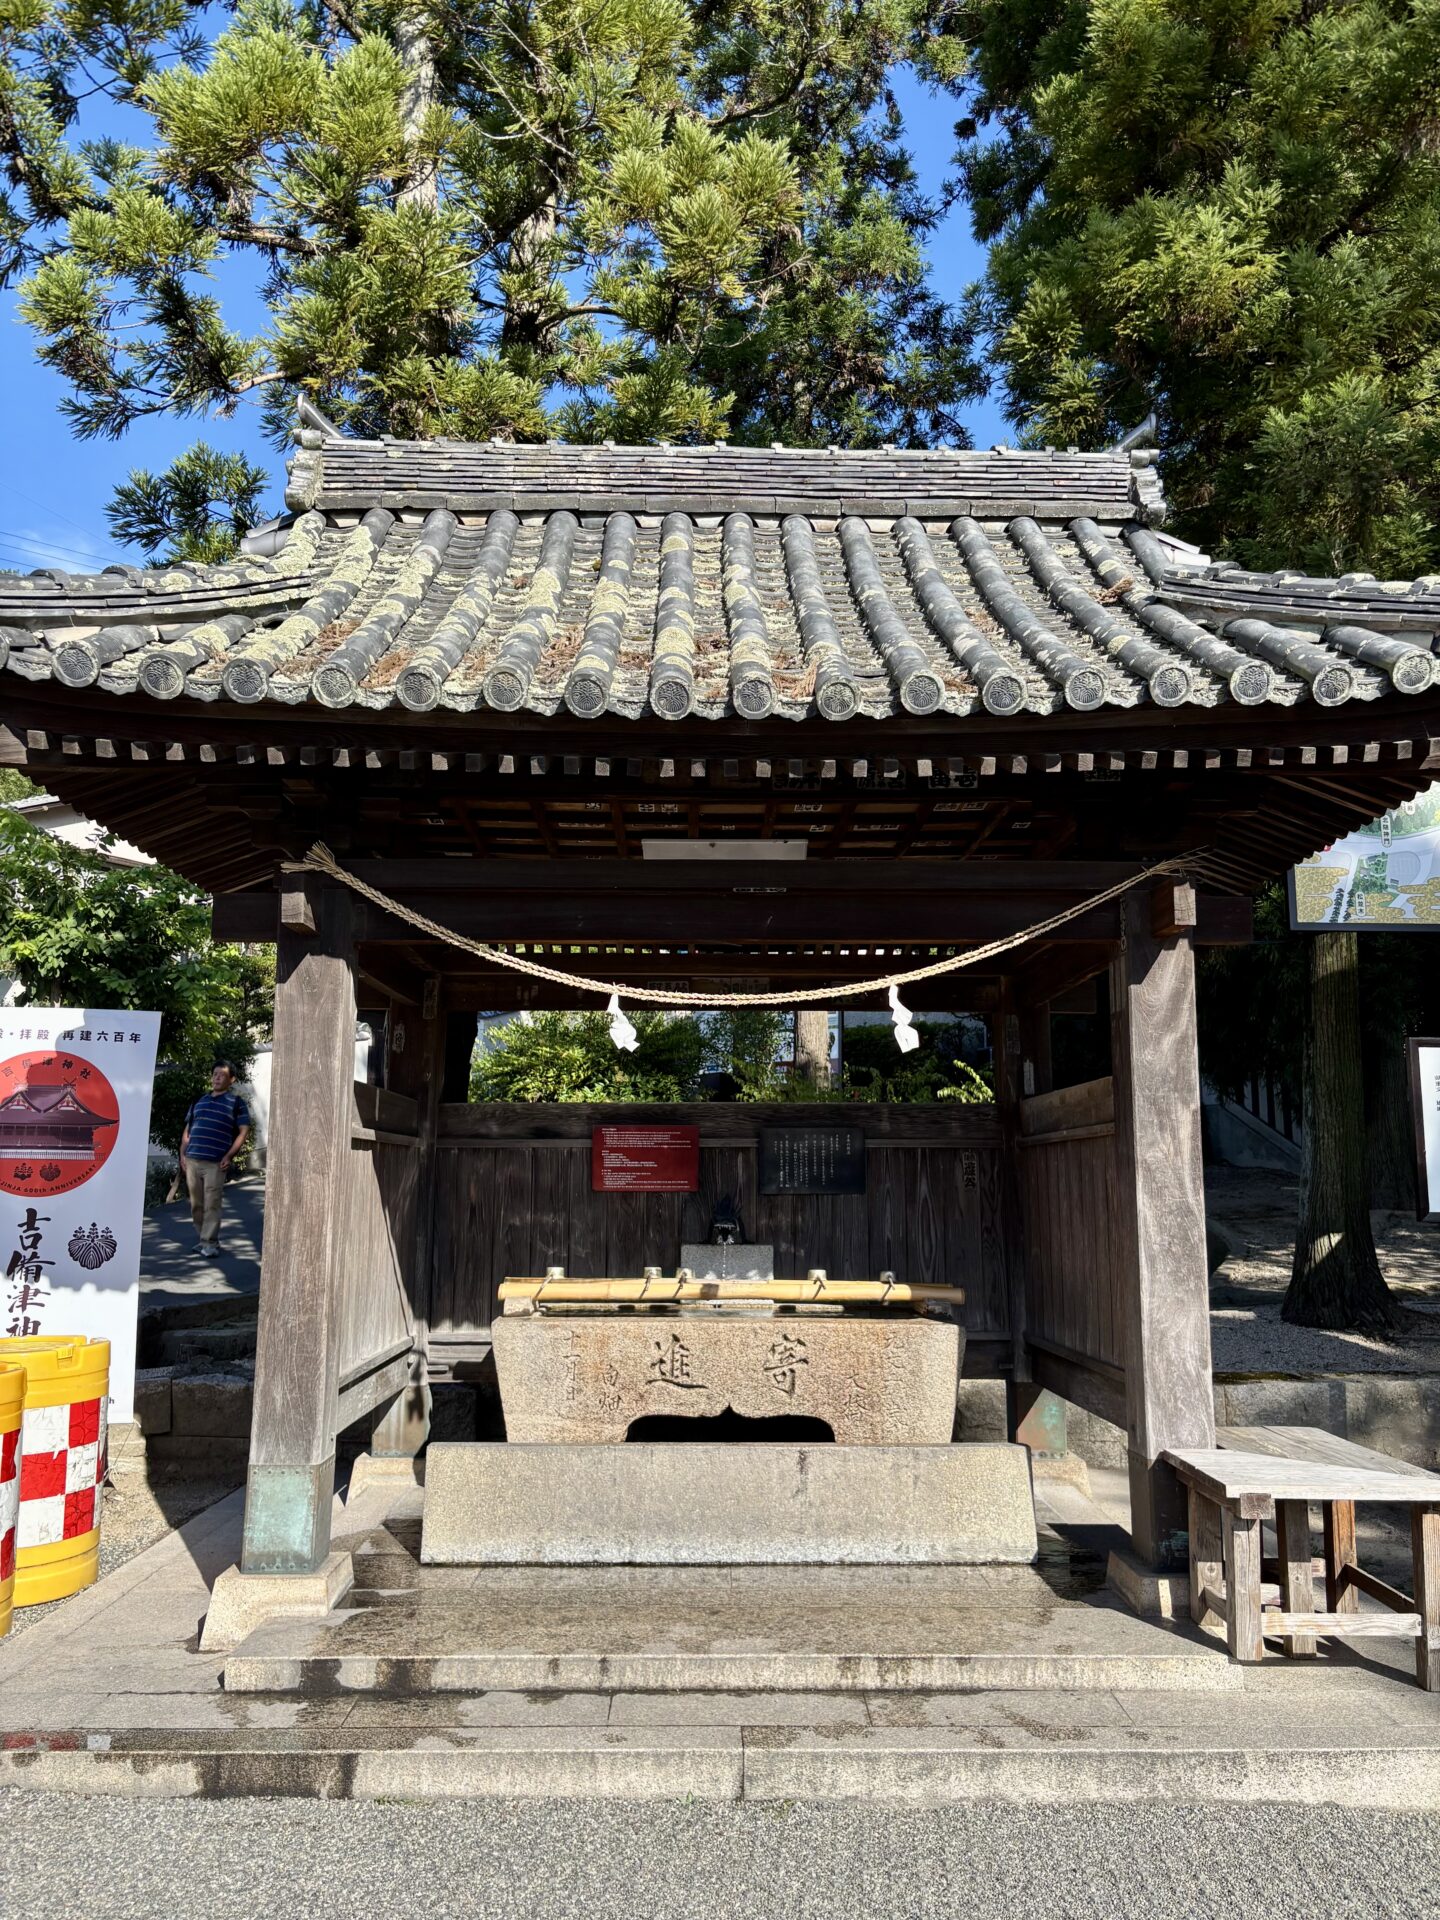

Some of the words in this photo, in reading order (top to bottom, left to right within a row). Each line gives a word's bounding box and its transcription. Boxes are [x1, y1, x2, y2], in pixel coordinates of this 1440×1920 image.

[0, 1028, 50, 1040] ・拝殿
[62, 1029, 142, 1043] 再建六百年
[0, 1181, 21, 1191] JINJA
[49, 1164, 97, 1192] ANNIVERSARY
[6, 1208, 56, 1337] 吉備津神
